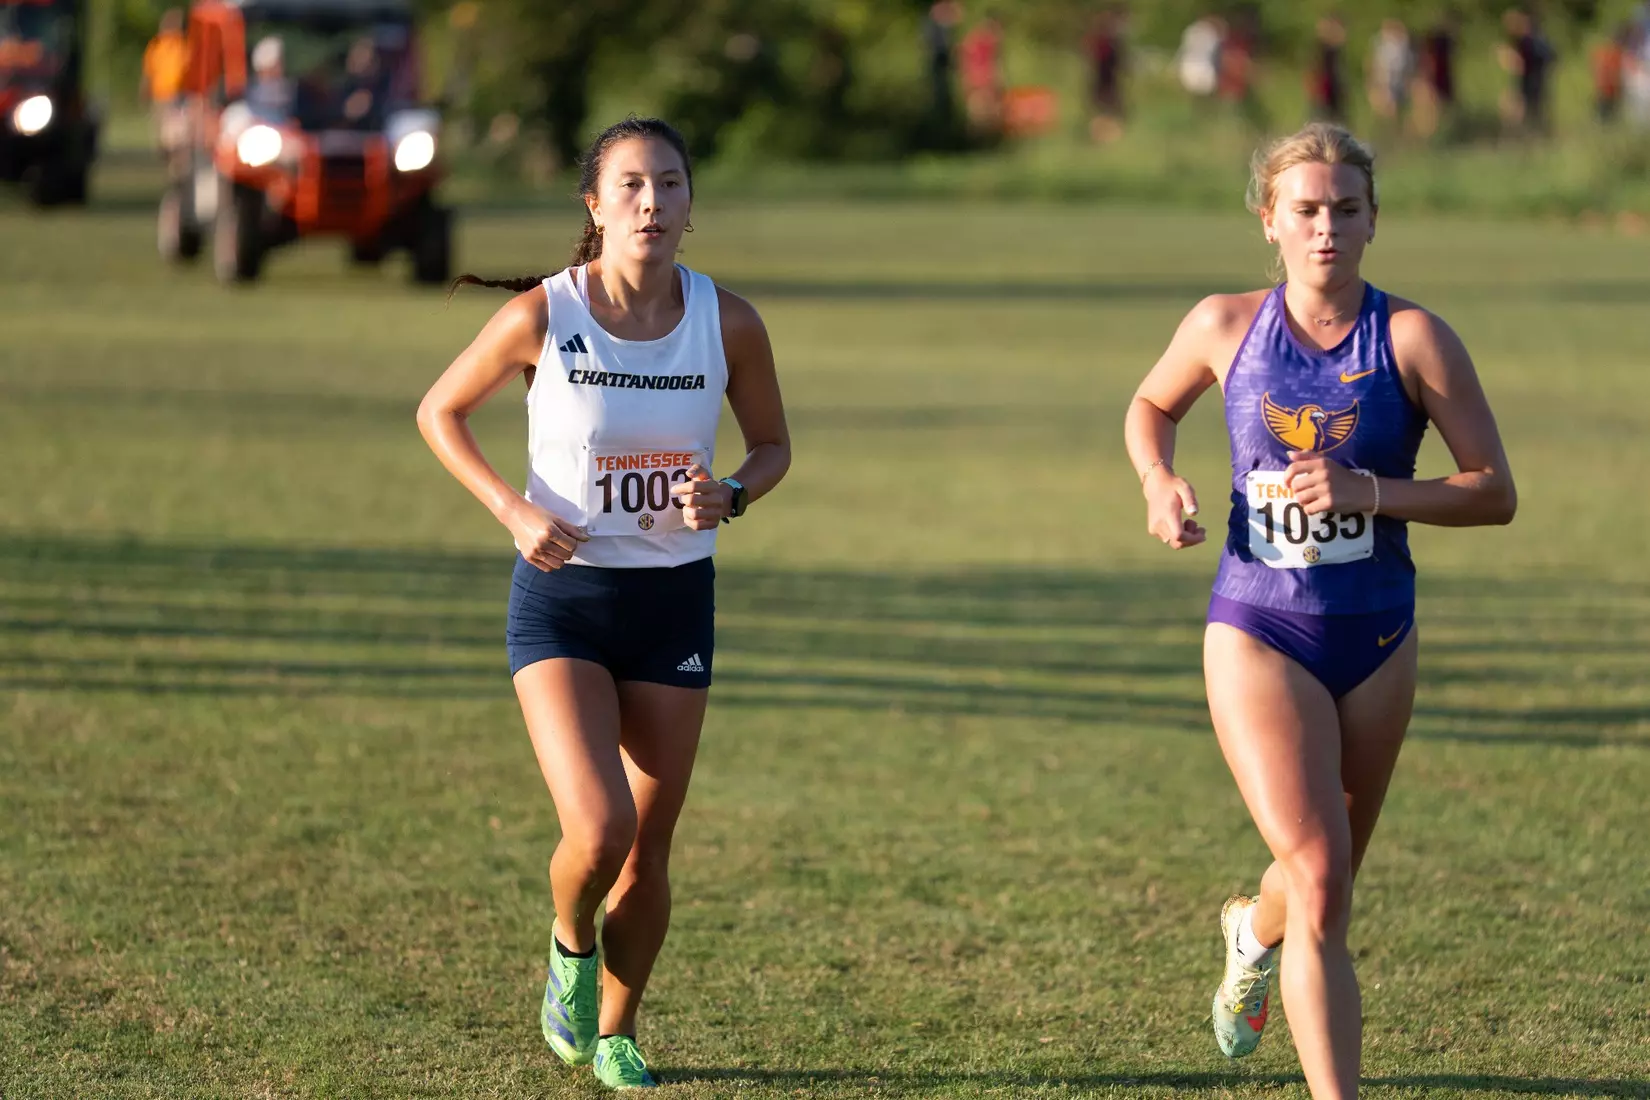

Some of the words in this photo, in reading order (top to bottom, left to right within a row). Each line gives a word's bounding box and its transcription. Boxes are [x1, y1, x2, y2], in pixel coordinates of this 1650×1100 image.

[568, 369, 705, 390] CHATTANOOGA
[595, 453, 693, 472] TENNESSEE
[1257, 502, 1365, 544] 1035
[677, 664, 704, 672] adidas
